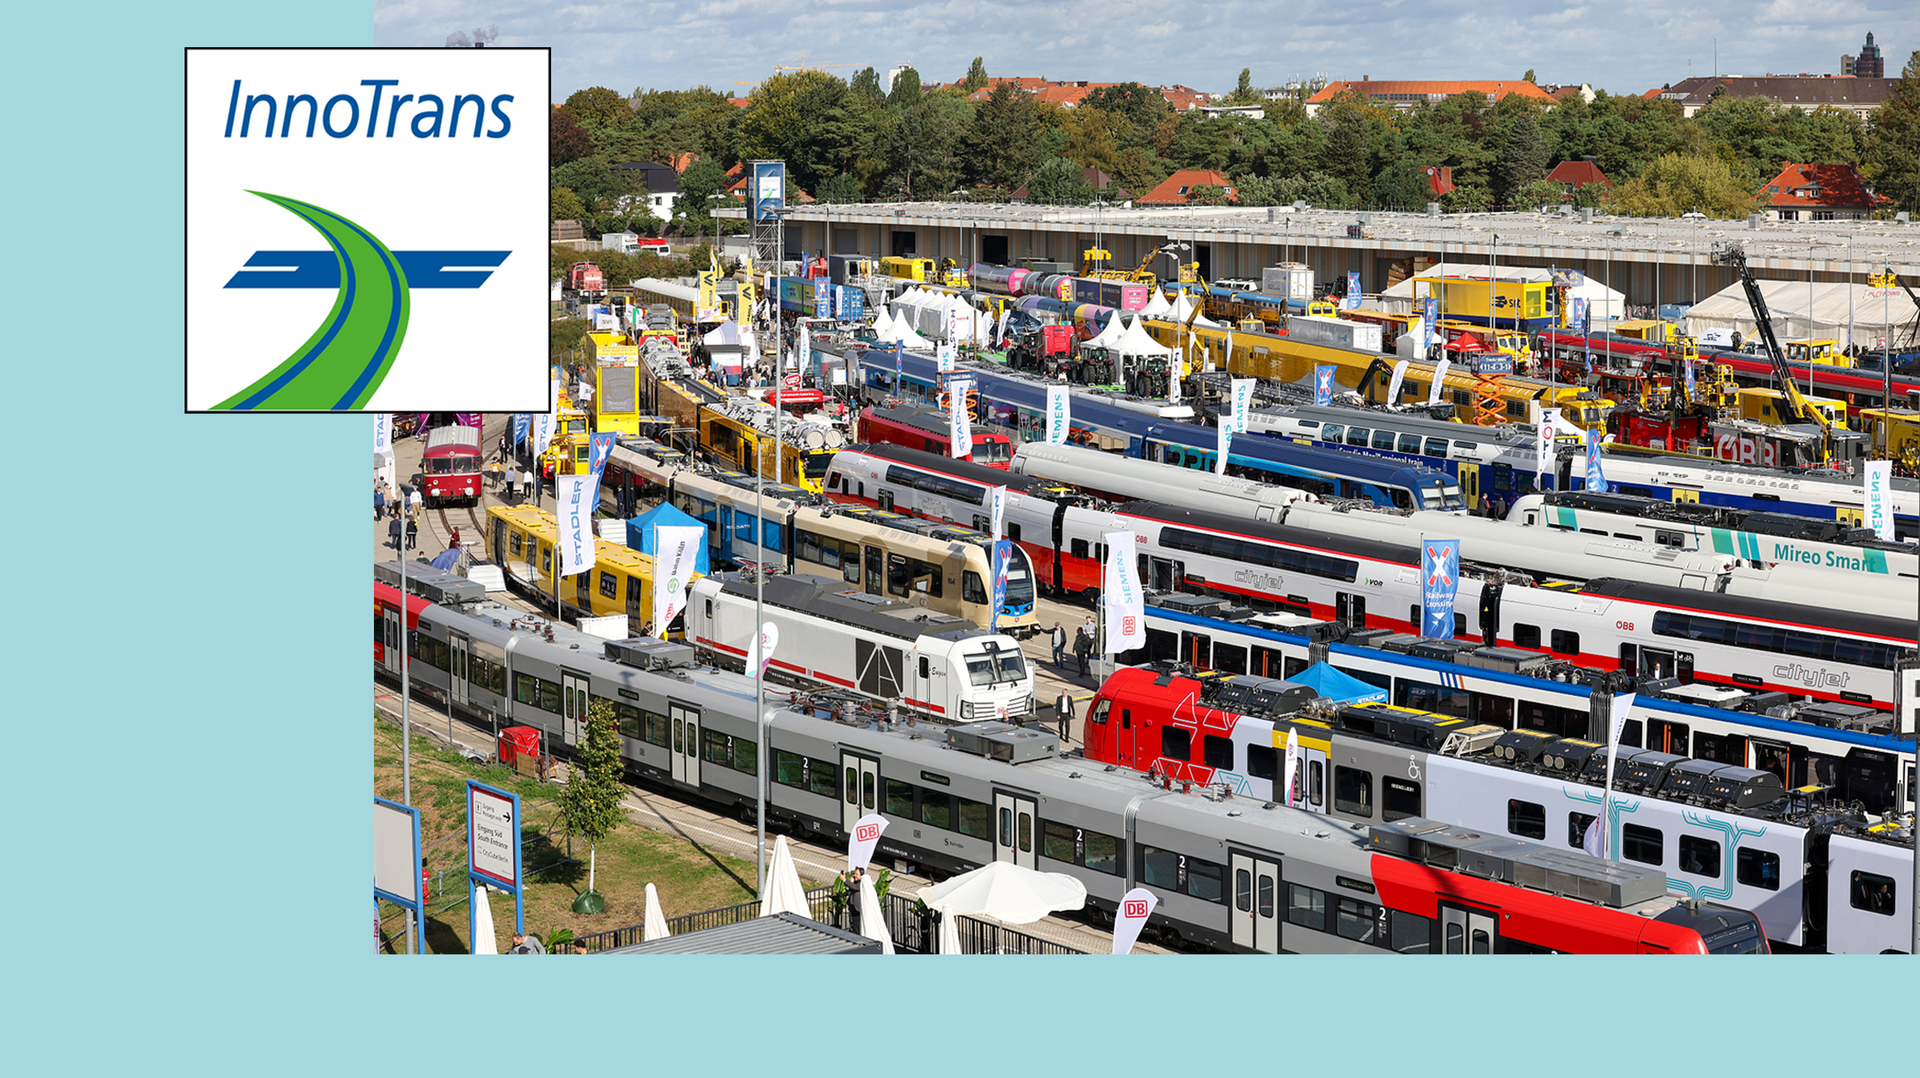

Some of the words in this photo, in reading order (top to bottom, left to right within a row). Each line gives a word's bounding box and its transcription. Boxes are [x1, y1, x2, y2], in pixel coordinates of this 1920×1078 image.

[1052, 393, 1064, 443] IEMENS
[376, 413, 385, 447] STAD
[539, 414, 549, 452] STAD
[570, 480, 584, 567] STADLER
[1774, 543, 1822, 566] Mireo
[1824, 548, 1876, 573] Smart
[1116, 549, 1133, 605] SIEMENS
[1234, 569, 1284, 590] cityjet
[1369, 579, 1384, 588] VOR
[1426, 591, 1454, 600] Railway
[1615, 618, 1635, 632] ÖBB
[1773, 663, 1850, 688] cityjet
[1357, 693, 1387, 704] STADLER
[727, 735, 733, 747] 2
[803, 757, 809, 769] 2
[857, 826, 878, 840] DB
[1076, 828, 1083, 841] 2
[1179, 855, 1186, 869] 2
[1126, 902, 1146, 916] DB
[1379, 906, 1386, 920] 2
